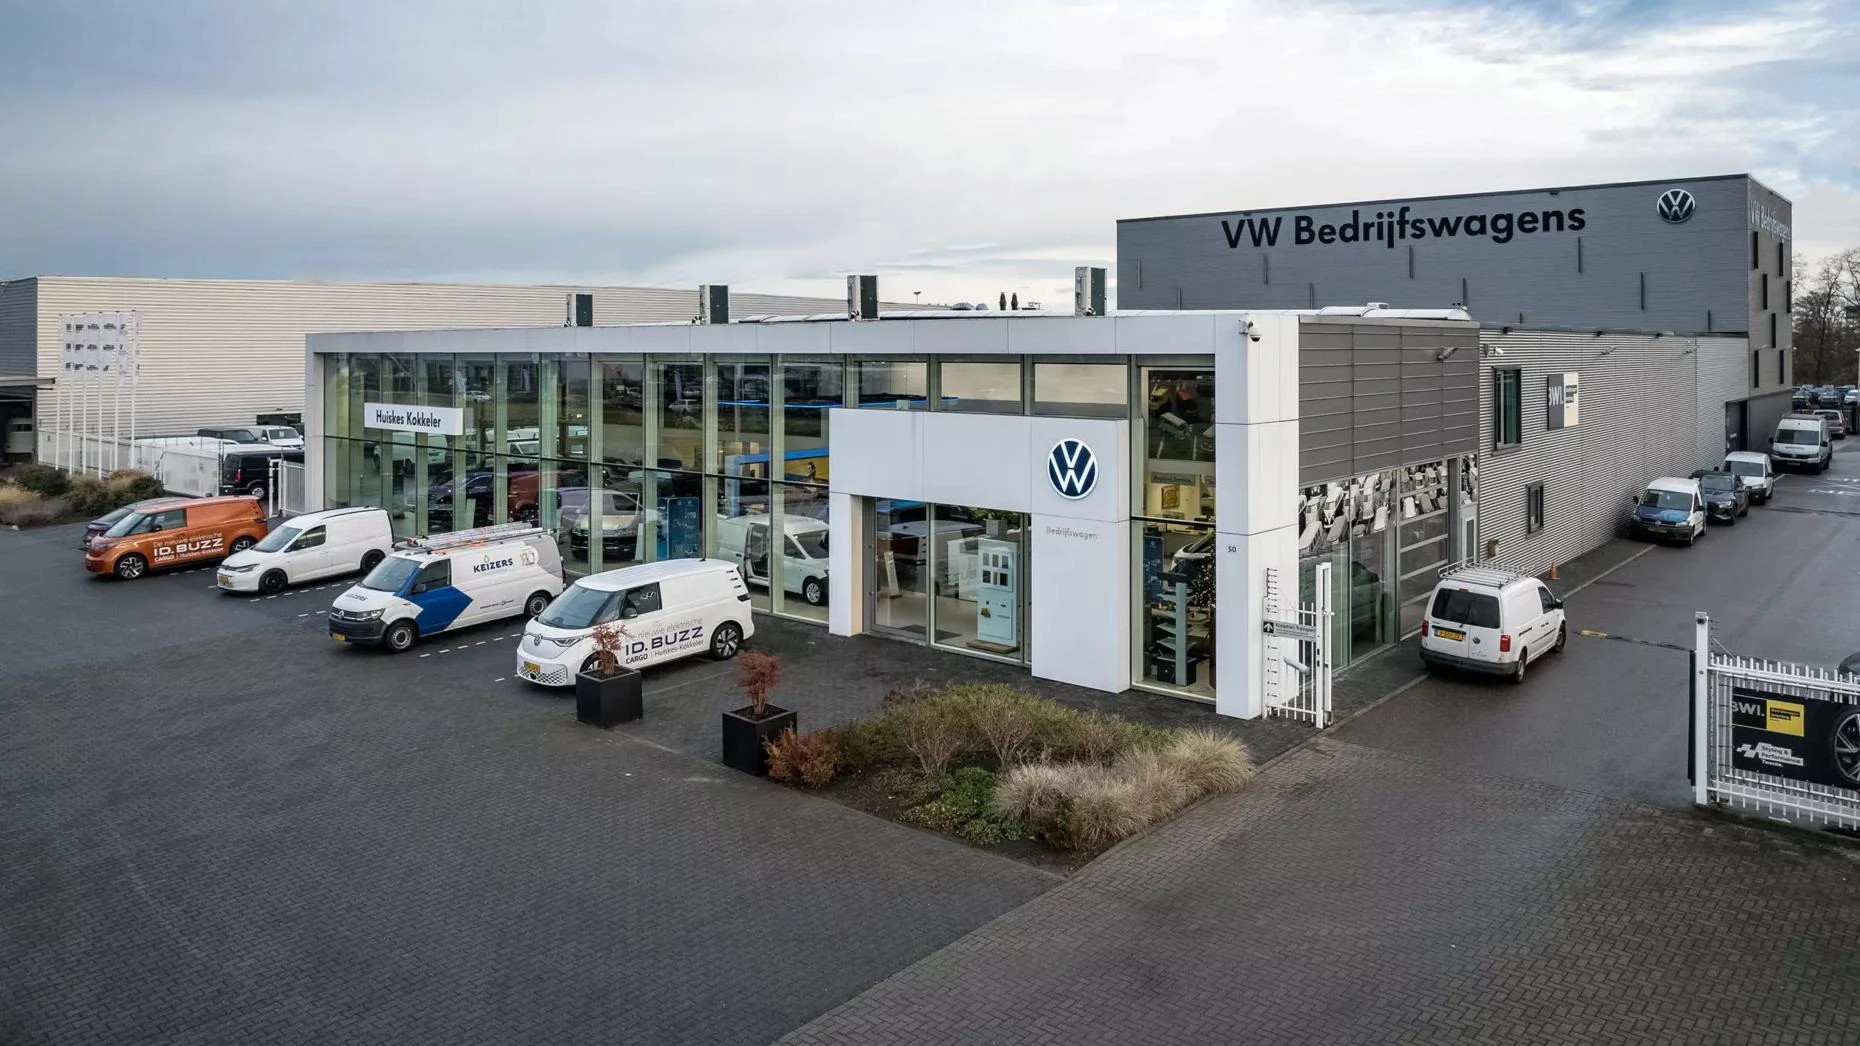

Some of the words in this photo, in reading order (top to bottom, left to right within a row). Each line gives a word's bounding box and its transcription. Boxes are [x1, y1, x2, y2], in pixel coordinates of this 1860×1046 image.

[1221, 216, 1282, 249] VW
[1295, 206, 1586, 249] Bedrijfswagens
[376, 409, 405, 425] Huiskes
[406, 411, 441, 427] Kokkeler
[1046, 526, 1101, 540] Bedrijfswagen
[1227, 545, 1237, 553] 50
[473, 558, 514, 573] KEIZERS
[638, 627, 665, 639] nieuwe
[667, 618, 703, 633] elektrische
[626, 653, 648, 664] CARGO
[1761, 745, 1783, 756] Styling
[1761, 752, 1801, 764] Performance
